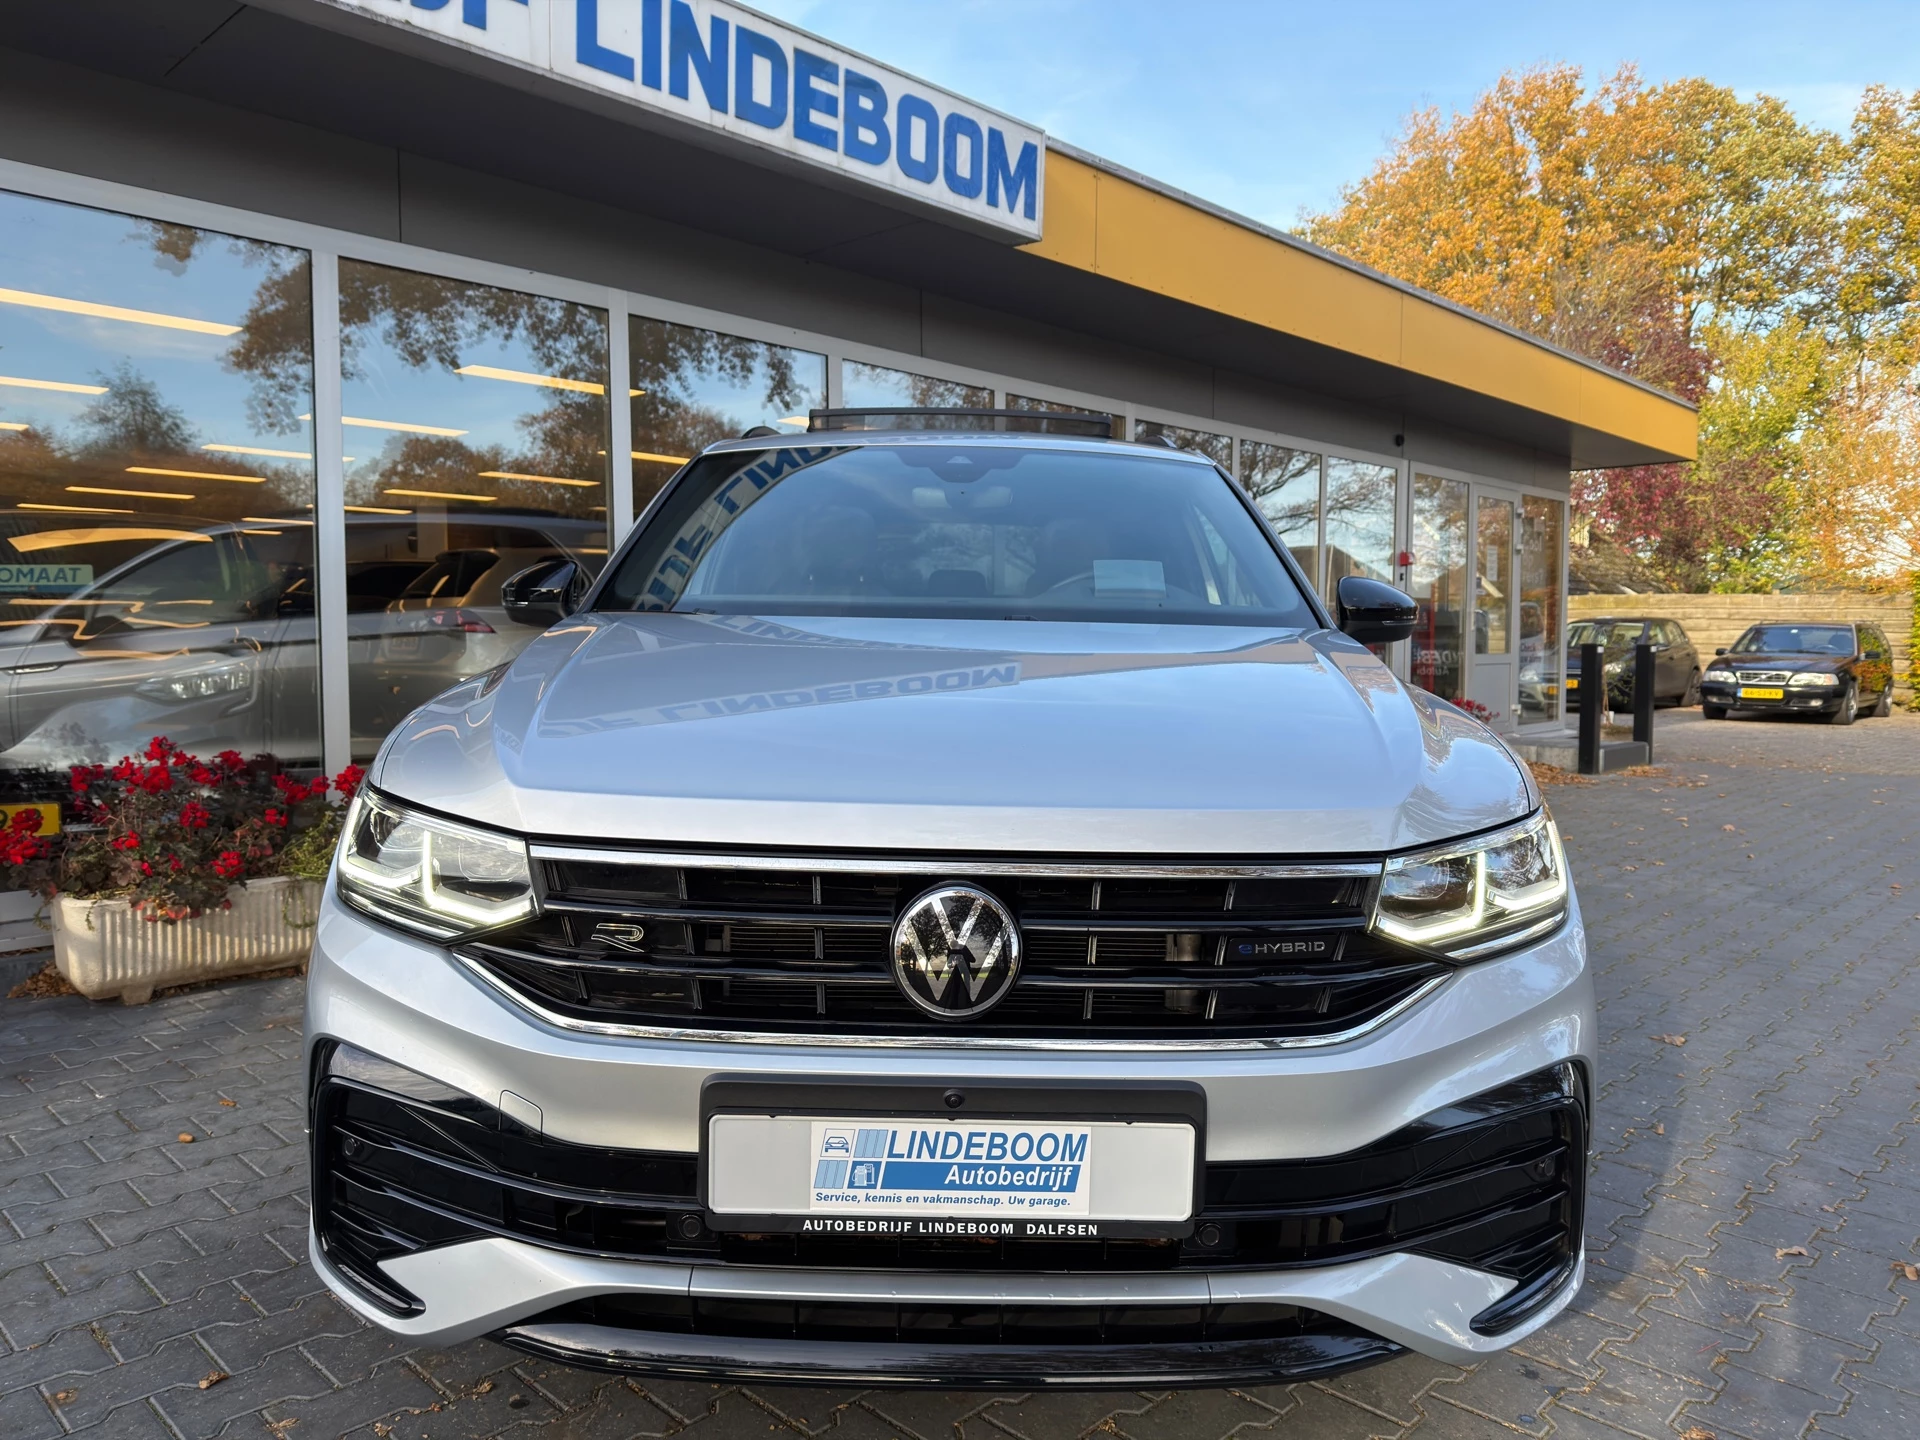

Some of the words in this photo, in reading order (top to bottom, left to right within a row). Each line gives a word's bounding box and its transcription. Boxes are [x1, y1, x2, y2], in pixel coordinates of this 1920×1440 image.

[576, 0, 1037, 222] LINDEBOOM
[887, 1130, 1088, 1162] LINDEBOOM
[944, 1164, 1073, 1192] Autobedrijf
[815, 1192, 861, 1204] Service,
[864, 1192, 903, 1203] kennis
[905, 1194, 920, 1203] en
[923, 1193, 1004, 1207] vakmanschap.
[1008, 1195, 1026, 1205] Uw
[1029, 1197, 1071, 1208] garage.
[802, 1219, 913, 1233] AUTOBEDRIJF
[919, 1221, 1014, 1235] LINDEBOOM
[1026, 1223, 1098, 1236] DALFSEN
